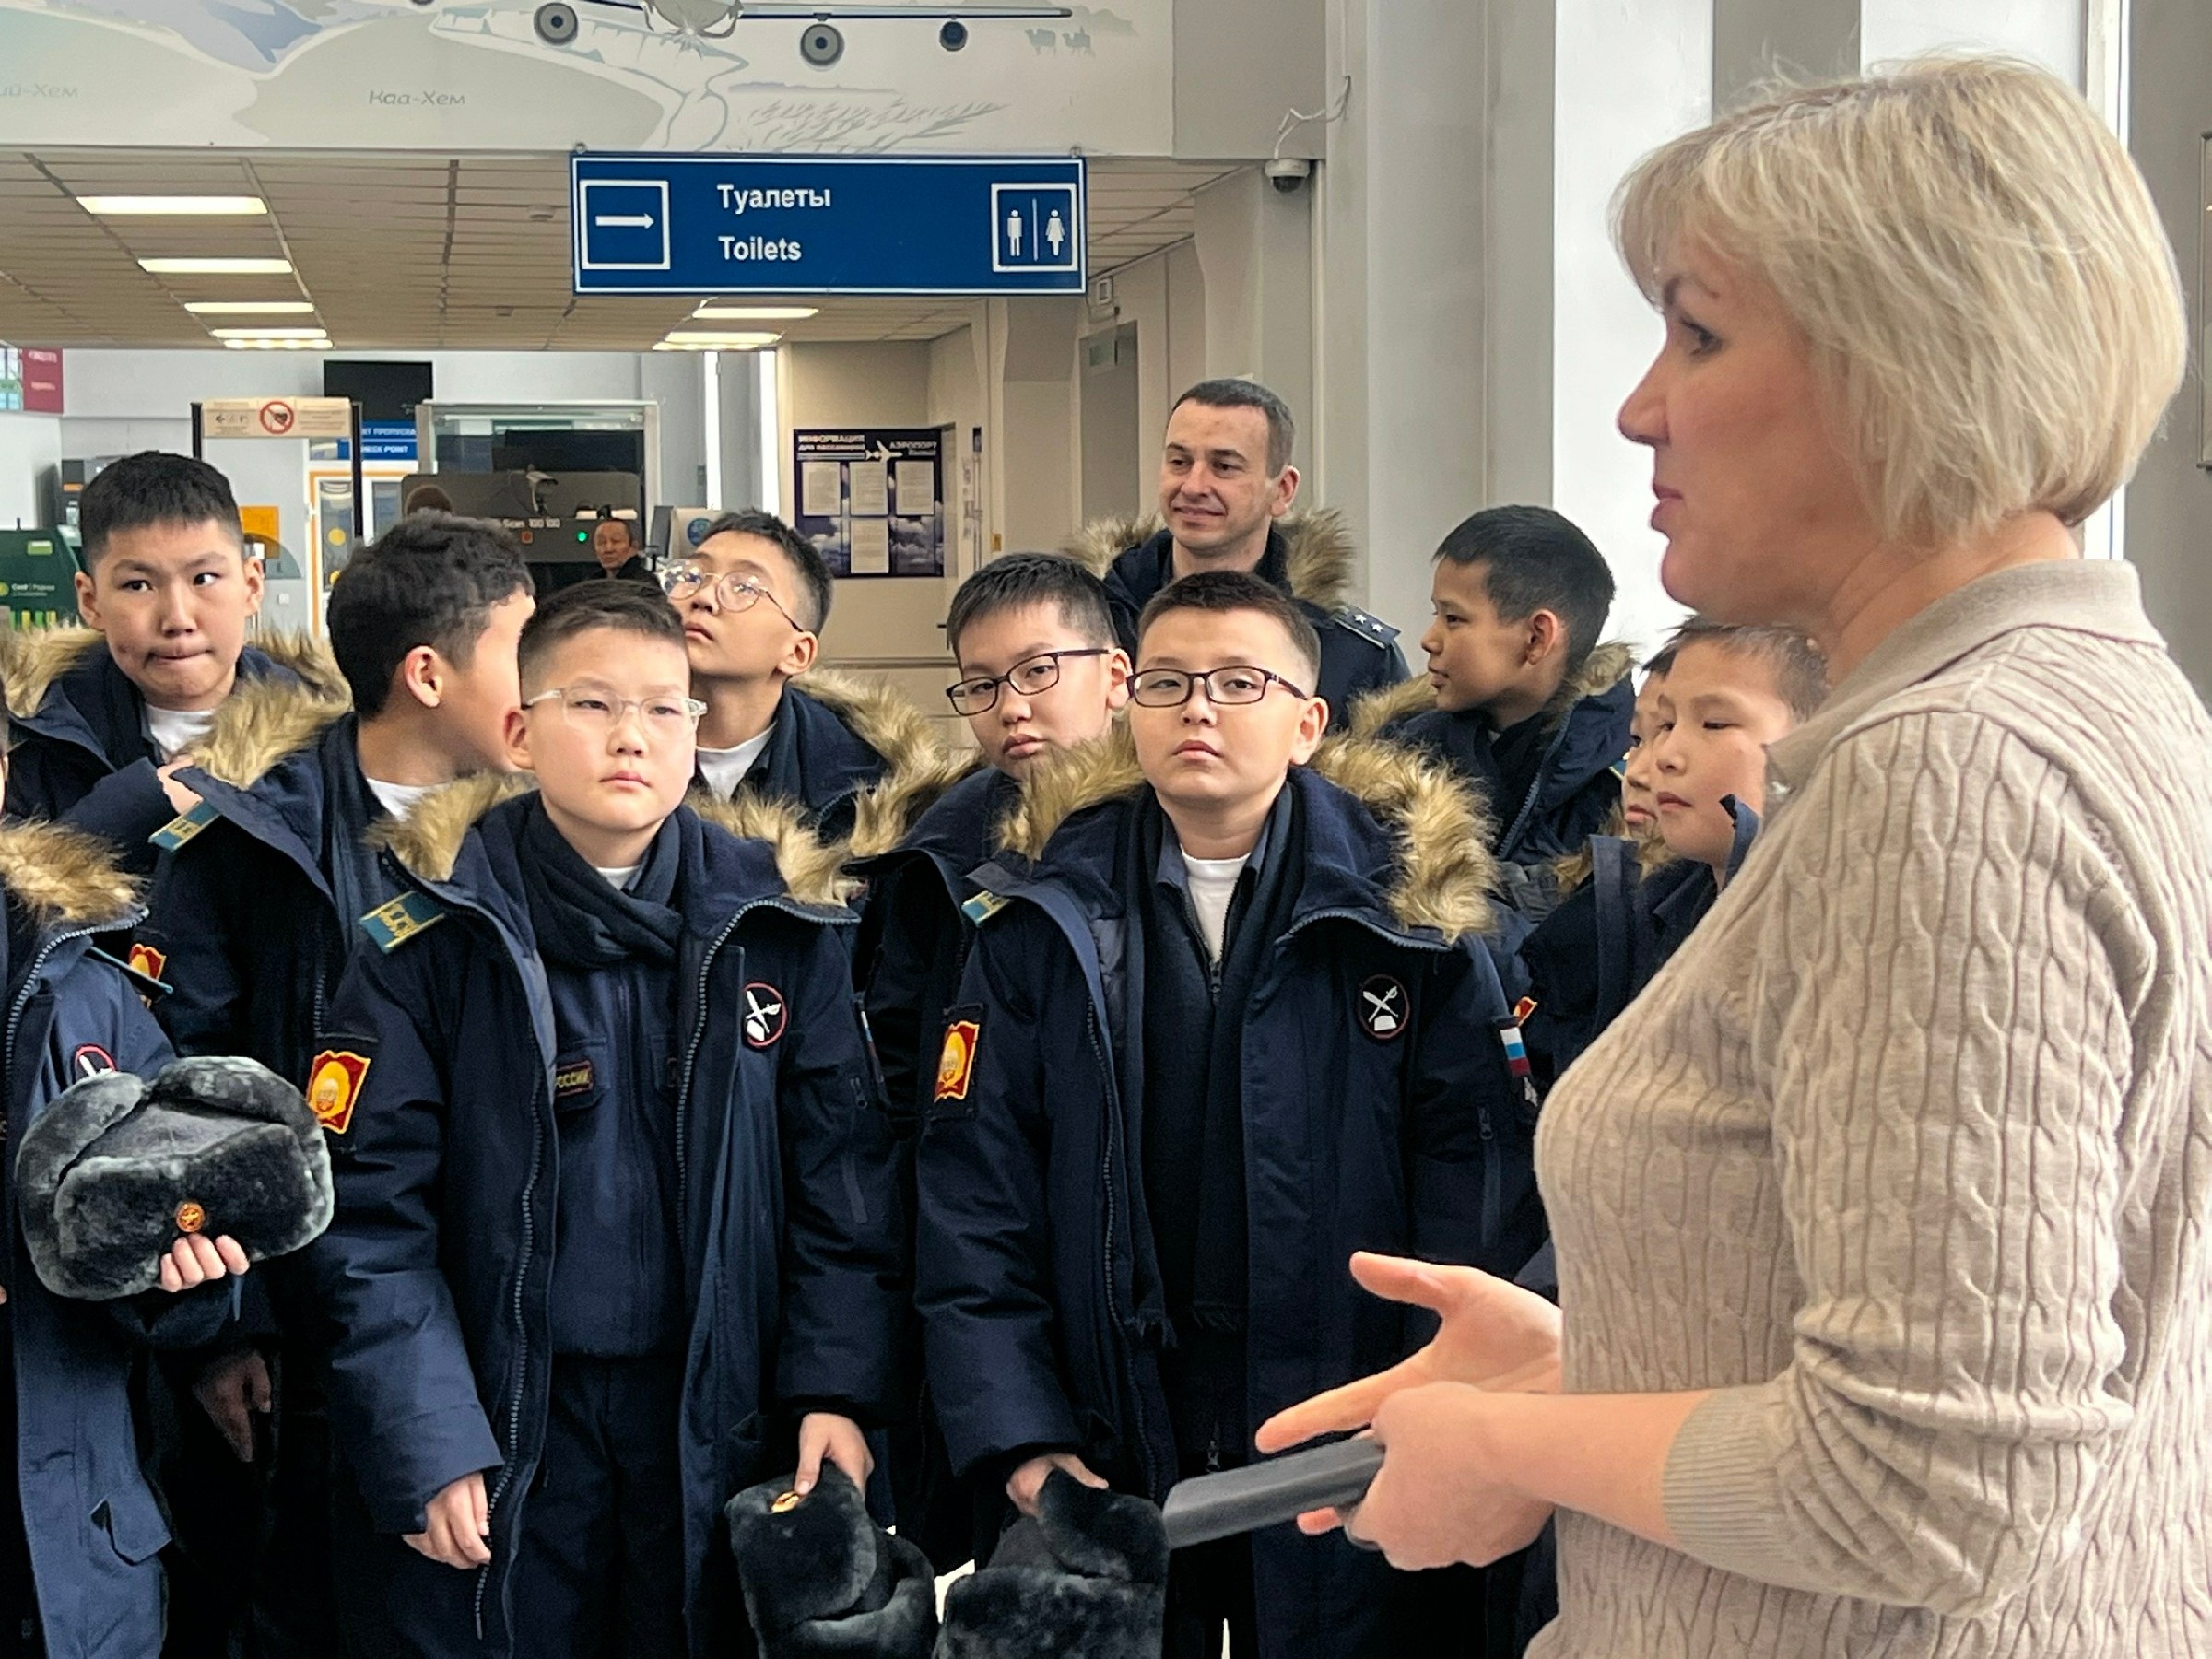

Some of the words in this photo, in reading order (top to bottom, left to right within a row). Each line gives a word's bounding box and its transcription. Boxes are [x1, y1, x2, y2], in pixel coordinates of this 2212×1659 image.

[369, 89, 465, 105] Каа-Хем
[716, 183, 831, 215] Туалеты
[717, 235, 802, 261] Toilets
